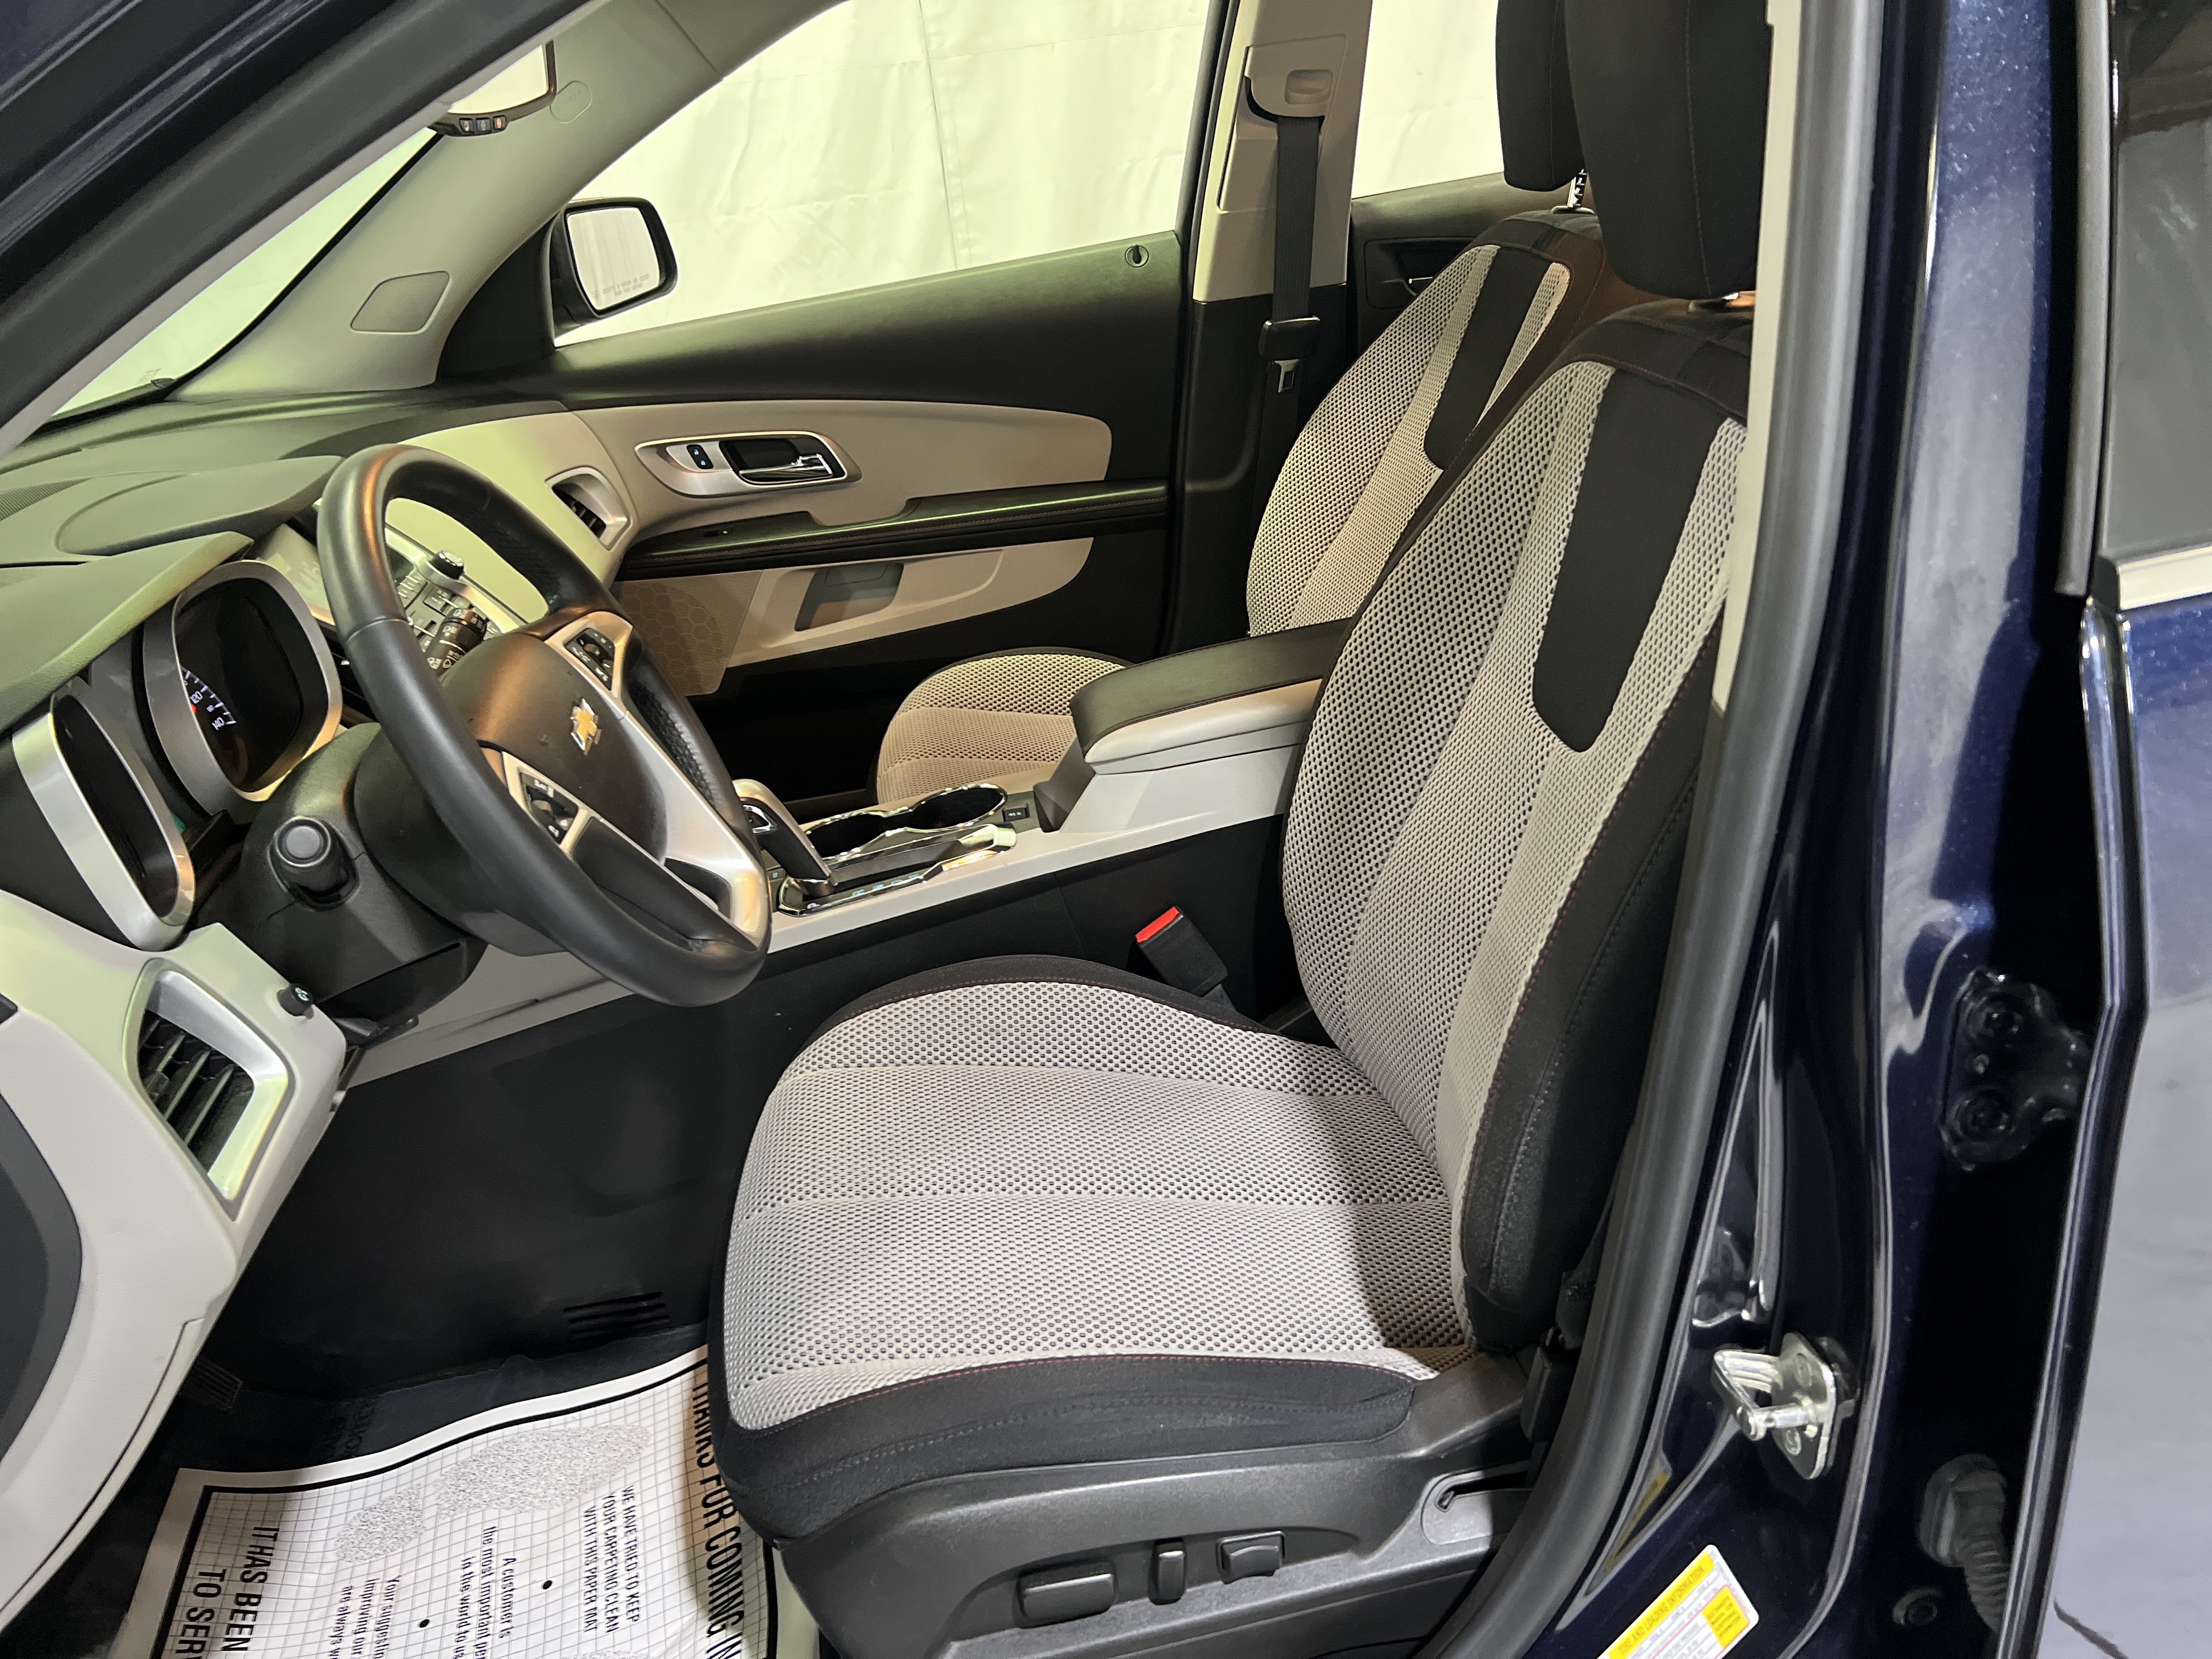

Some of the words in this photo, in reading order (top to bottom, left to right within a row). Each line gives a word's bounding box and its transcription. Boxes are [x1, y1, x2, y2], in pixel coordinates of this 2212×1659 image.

[602, 1491, 616, 1525] YOUR
[622, 1485, 635, 1505] WE
[251, 1526, 280, 1542] IT
[483, 1526, 496, 1545] the
[583, 1505, 597, 1537] WITH
[623, 1505, 637, 1537] HAVE
[240, 1544, 275, 1583] HAS
[461, 1555, 476, 1570] in
[481, 1548, 494, 1579] most
[502, 1558, 516, 1567] A
[584, 1537, 597, 1566] THIS
[603, 1526, 618, 1591] CARPETING
[624, 1537, 638, 1572] TRIED
[193, 1568, 227, 1598] TO
[339, 1585, 353, 1602] are
[384, 1575, 402, 1600] Your
[460, 1571, 474, 1592] the
[500, 1568, 517, 1624] customer
[583, 1567, 597, 1605] PAPER
[625, 1572, 639, 1590] TO
[705, 1526, 744, 1638] COMING
[352, 1578, 381, 1634] improving
[456, 1594, 472, 1629] world
[477, 1579, 496, 1640] important
[605, 1593, 619, 1633] CLEAN
[625, 1592, 641, 1622] KEEP
[1645, 1602, 1669, 1631] LOADING
[1667, 1565, 1705, 1606] INFORMATION
[221, 1593, 262, 1651] BEEN
[330, 1606, 351, 1645] always
[498, 1626, 514, 1639] is
[584, 1607, 597, 1633] MAT
[351, 1637, 365, 1655] our
[454, 1630, 470, 1643] to
